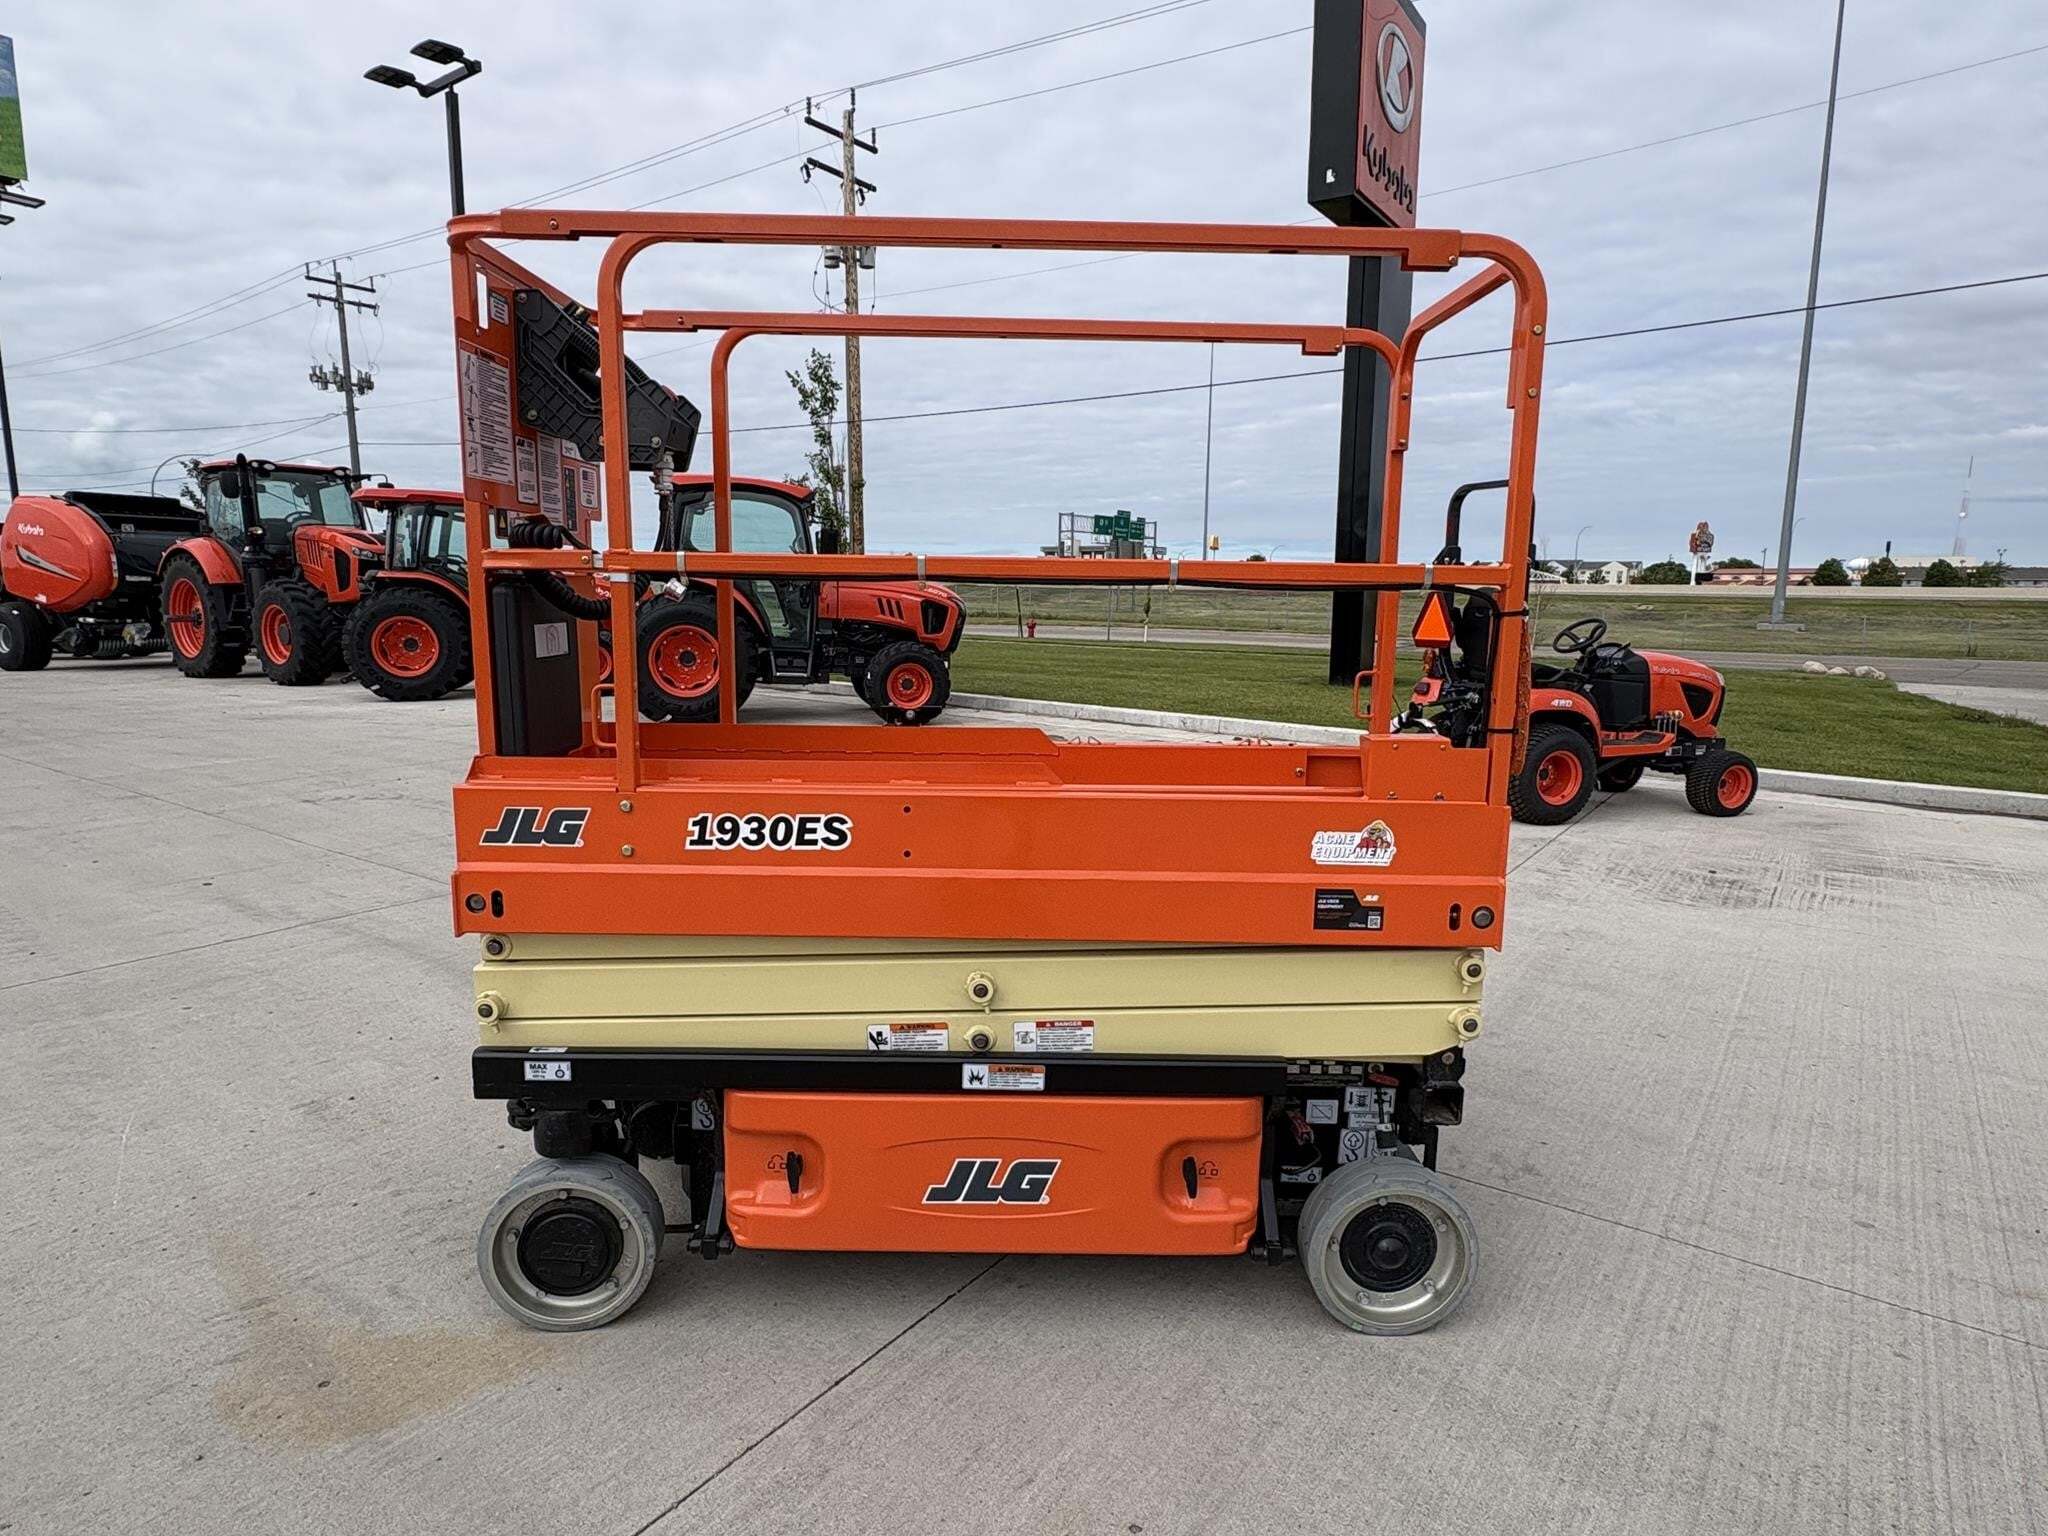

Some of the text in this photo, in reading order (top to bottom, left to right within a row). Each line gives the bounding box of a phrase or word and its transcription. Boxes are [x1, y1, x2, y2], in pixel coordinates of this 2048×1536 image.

[1362, 124, 1414, 214] Kubota
[18, 523, 43, 536] Kubota
[479, 806, 854, 851] JLG 1930ES
[1314, 833, 1356, 845] ACME
[1312, 846, 1394, 859] EQUIPMENT
[922, 1158, 1062, 1204] JLG
